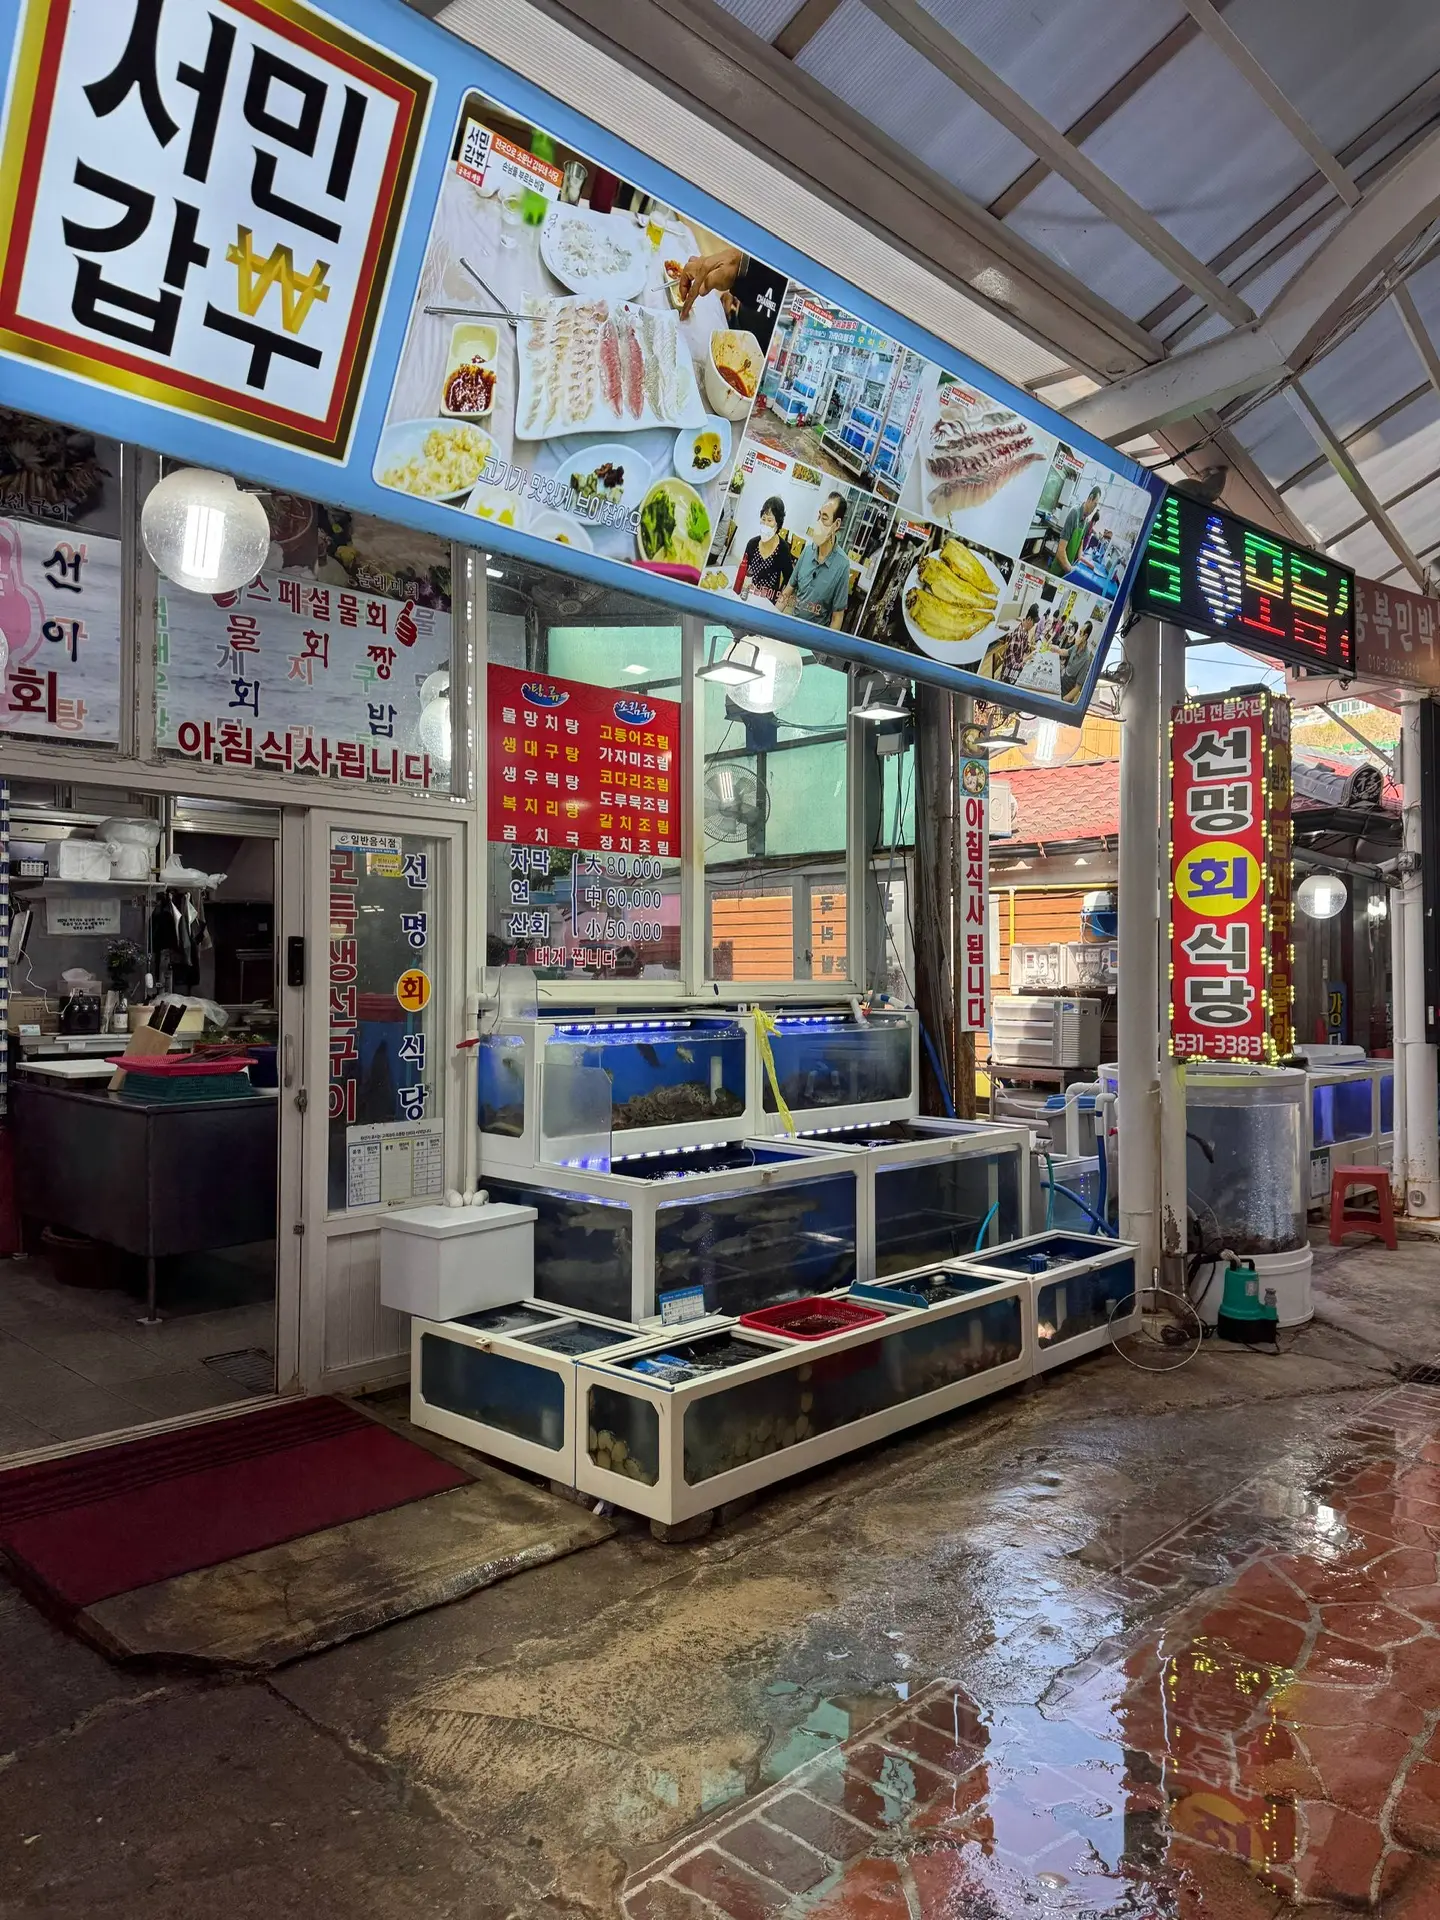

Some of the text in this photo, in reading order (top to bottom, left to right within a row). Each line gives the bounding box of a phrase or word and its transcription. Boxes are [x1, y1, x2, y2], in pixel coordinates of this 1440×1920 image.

[82, 0, 368, 244] 서민
[467, 126, 490, 150] 서민
[464, 144, 486, 168] 갑부
[478, 456, 528, 495] 고기가
[527, 474, 574, 512] 맛있게
[0, 488, 68, 521] 선구이
[247, 575, 387, 634] 스페셜물회
[1174, 699, 1264, 725] 40년 전통맛집
[599, 725, 669, 750] 고등어조림
[177, 721, 433, 788] 아침식사됩니다
[599, 747, 669, 772] 가자미조림
[599, 770, 669, 792] 코다리조림
[599, 792, 669, 813] 도루묵조림
[599, 813, 669, 835] 갈치조림
[350, 834, 396, 848] 일반음식점
[600, 834, 669, 856] 장치조림
[606, 856, 662, 880] 80,000
[606, 887, 662, 911] 60,000
[965, 797, 986, 1028] 아침식사 됩니다
[605, 918, 662, 942] 50,000
[535, 946, 566, 967] 대게
[1174, 1032, 1262, 1057] 531-3383
